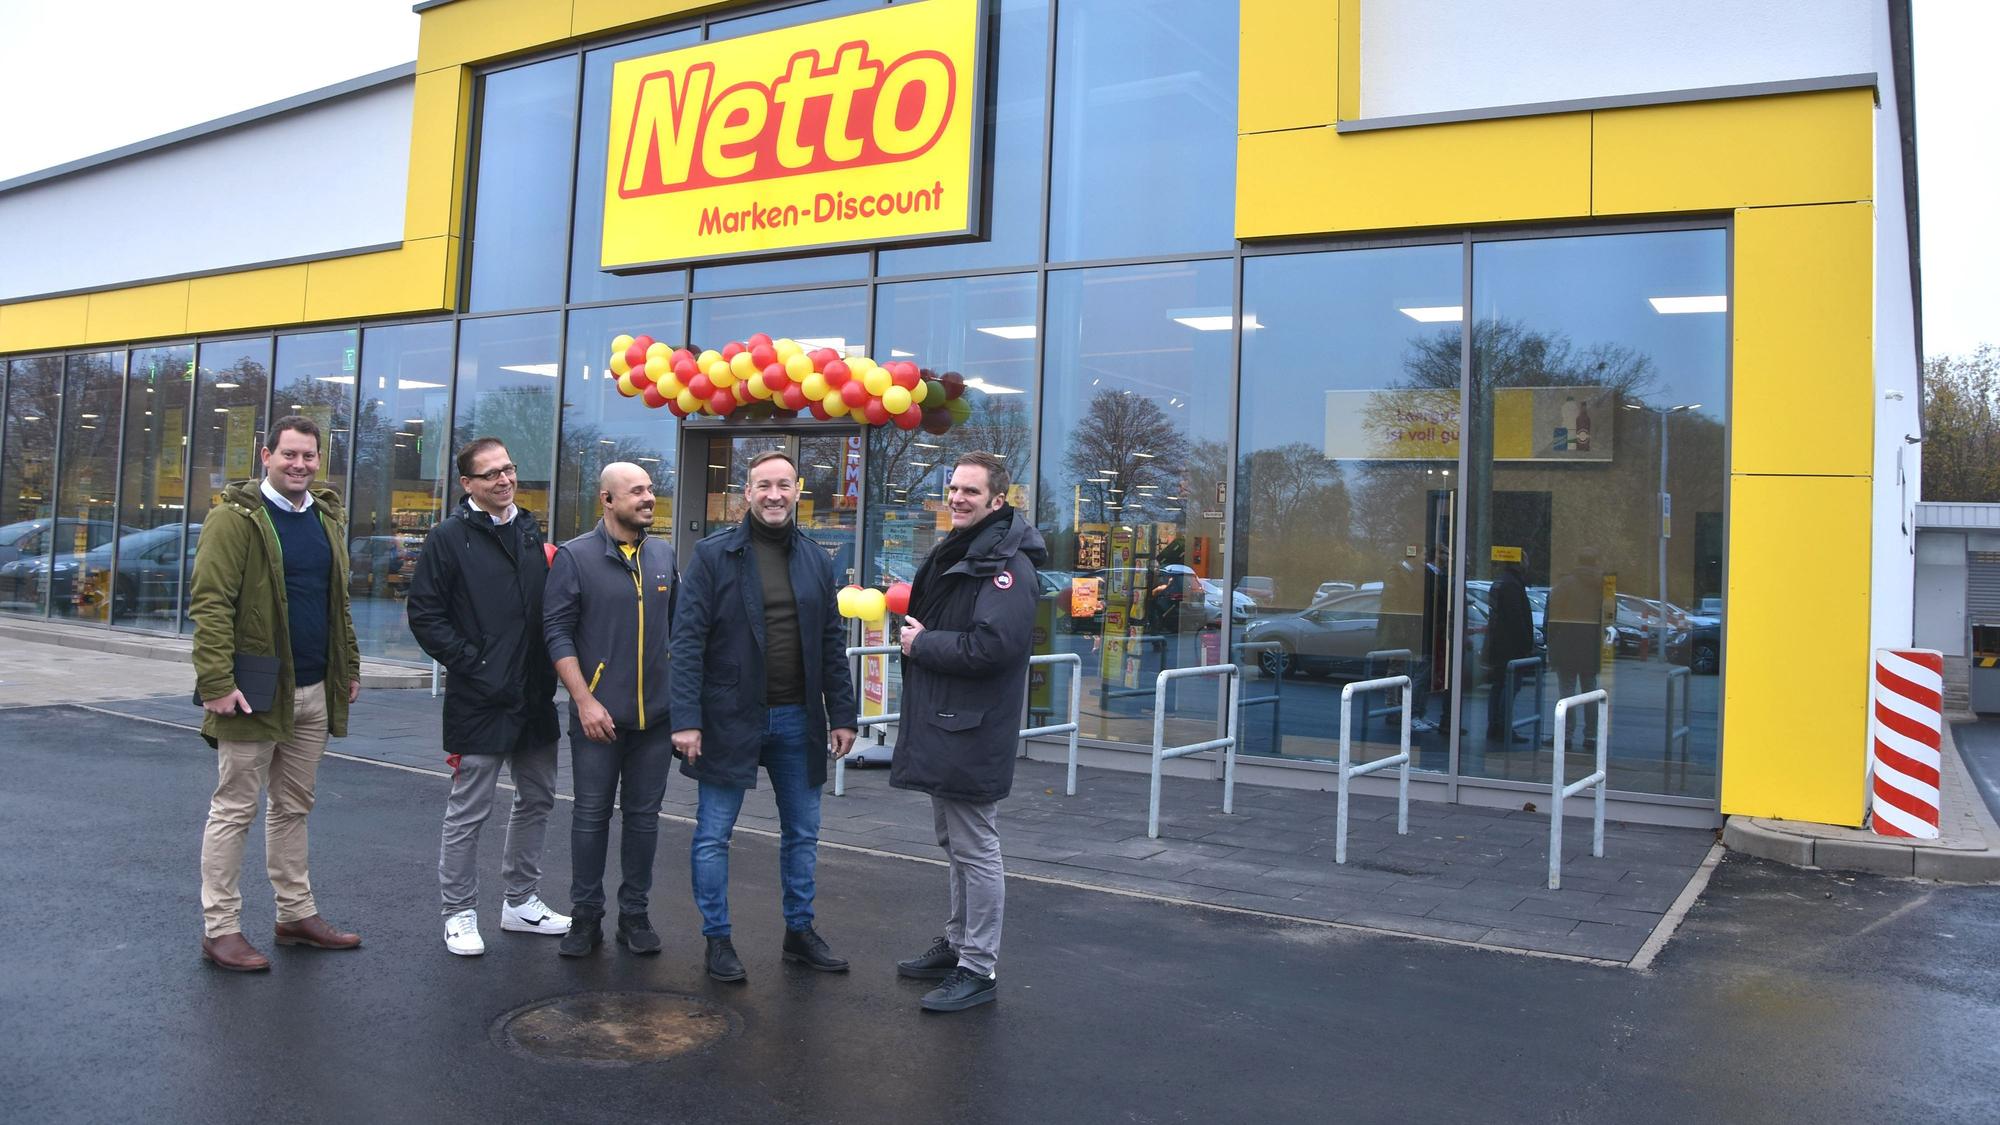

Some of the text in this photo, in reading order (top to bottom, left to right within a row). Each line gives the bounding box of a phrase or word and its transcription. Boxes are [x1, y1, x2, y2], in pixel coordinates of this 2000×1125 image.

[619, 40, 956, 198] Netto
[698, 181, 944, 236] Marken-Discount
[1408, 428, 1435, 441] voll
[1440, 430, 1459, 444] gu
